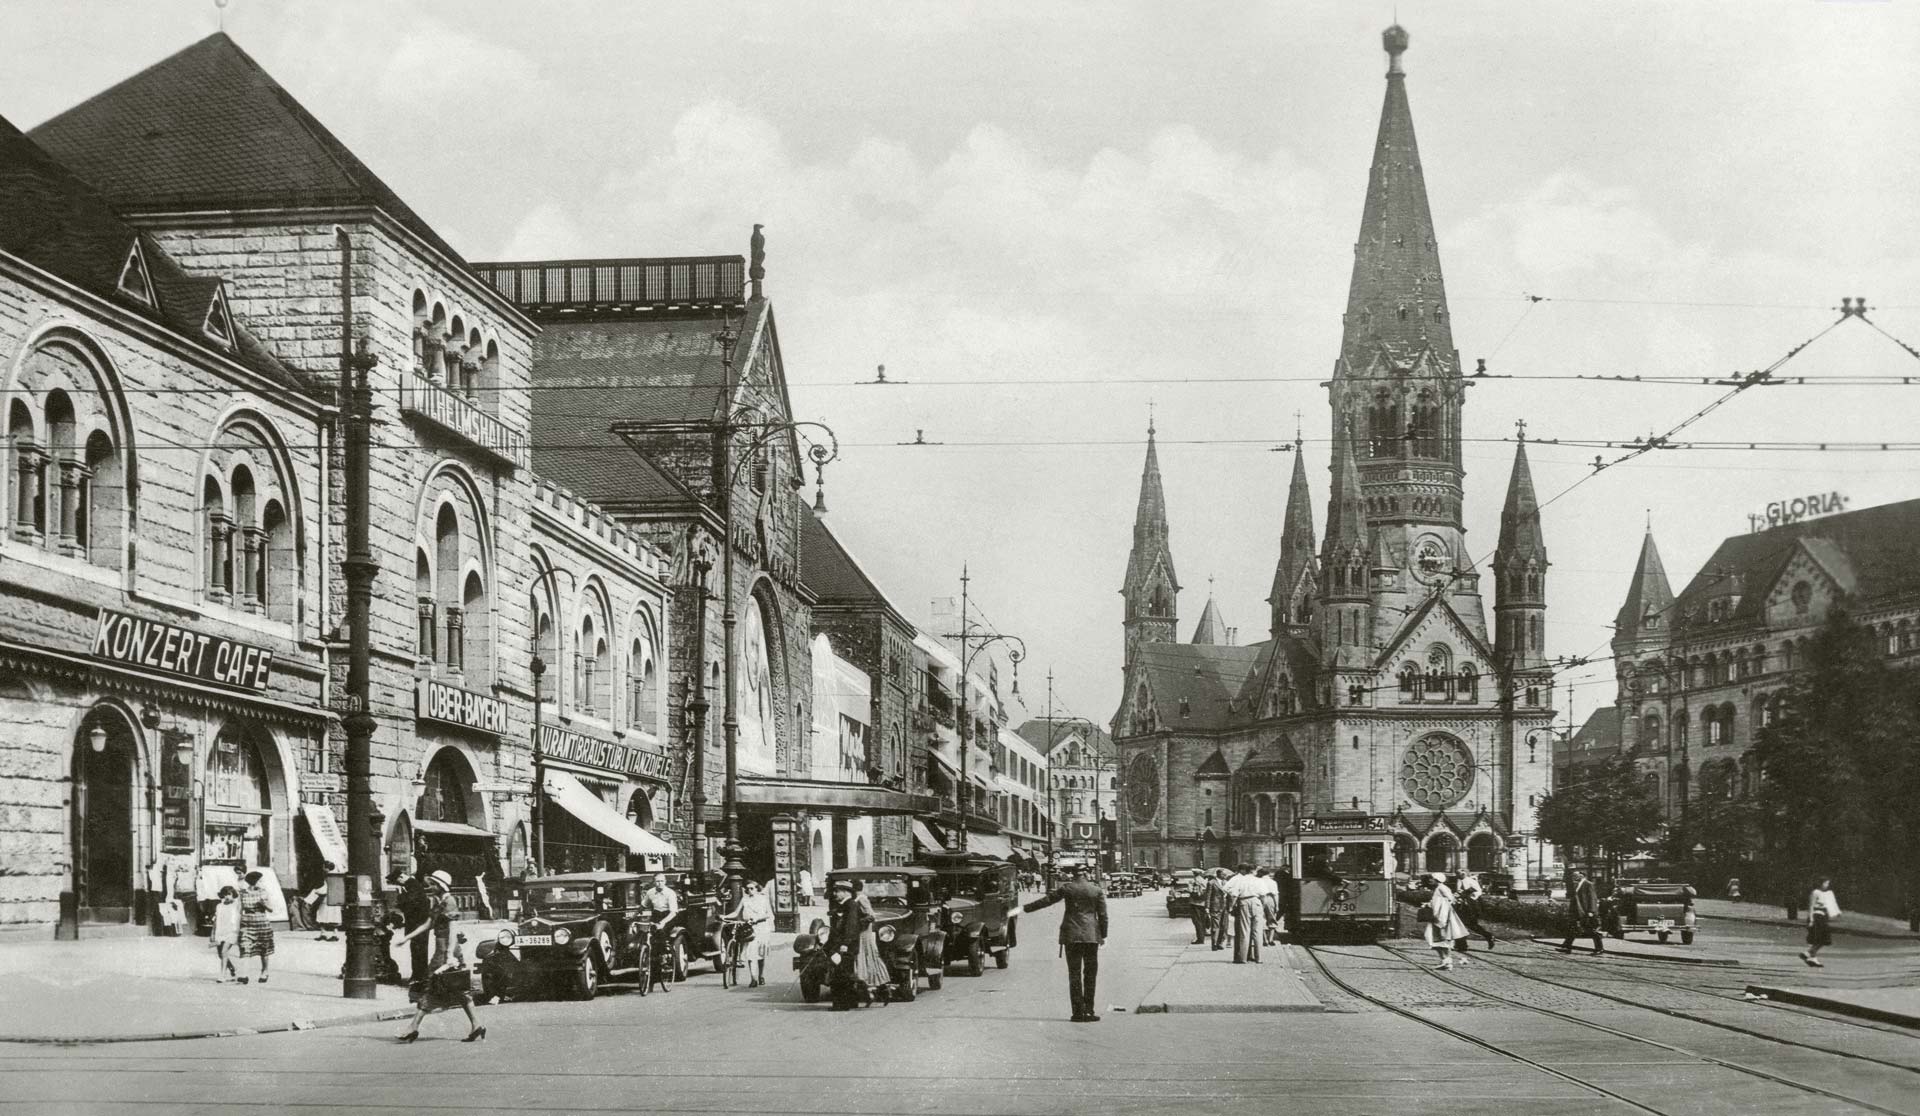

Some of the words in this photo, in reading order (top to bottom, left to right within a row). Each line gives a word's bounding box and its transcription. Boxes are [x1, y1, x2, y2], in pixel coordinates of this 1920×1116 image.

[1766, 491, 1844, 522] GLORIA
[94, 611, 211, 676] KONZERT
[214, 641, 271, 690] CAFE
[430, 683, 507, 734] OBER-BAYERN
[630, 750, 673, 780] TANZDIELE
[1080, 826, 1092, 839] U
[1301, 820, 1315, 832] 54
[1368, 818, 1385, 831] 54
[1330, 902, 1356, 912] 5730
